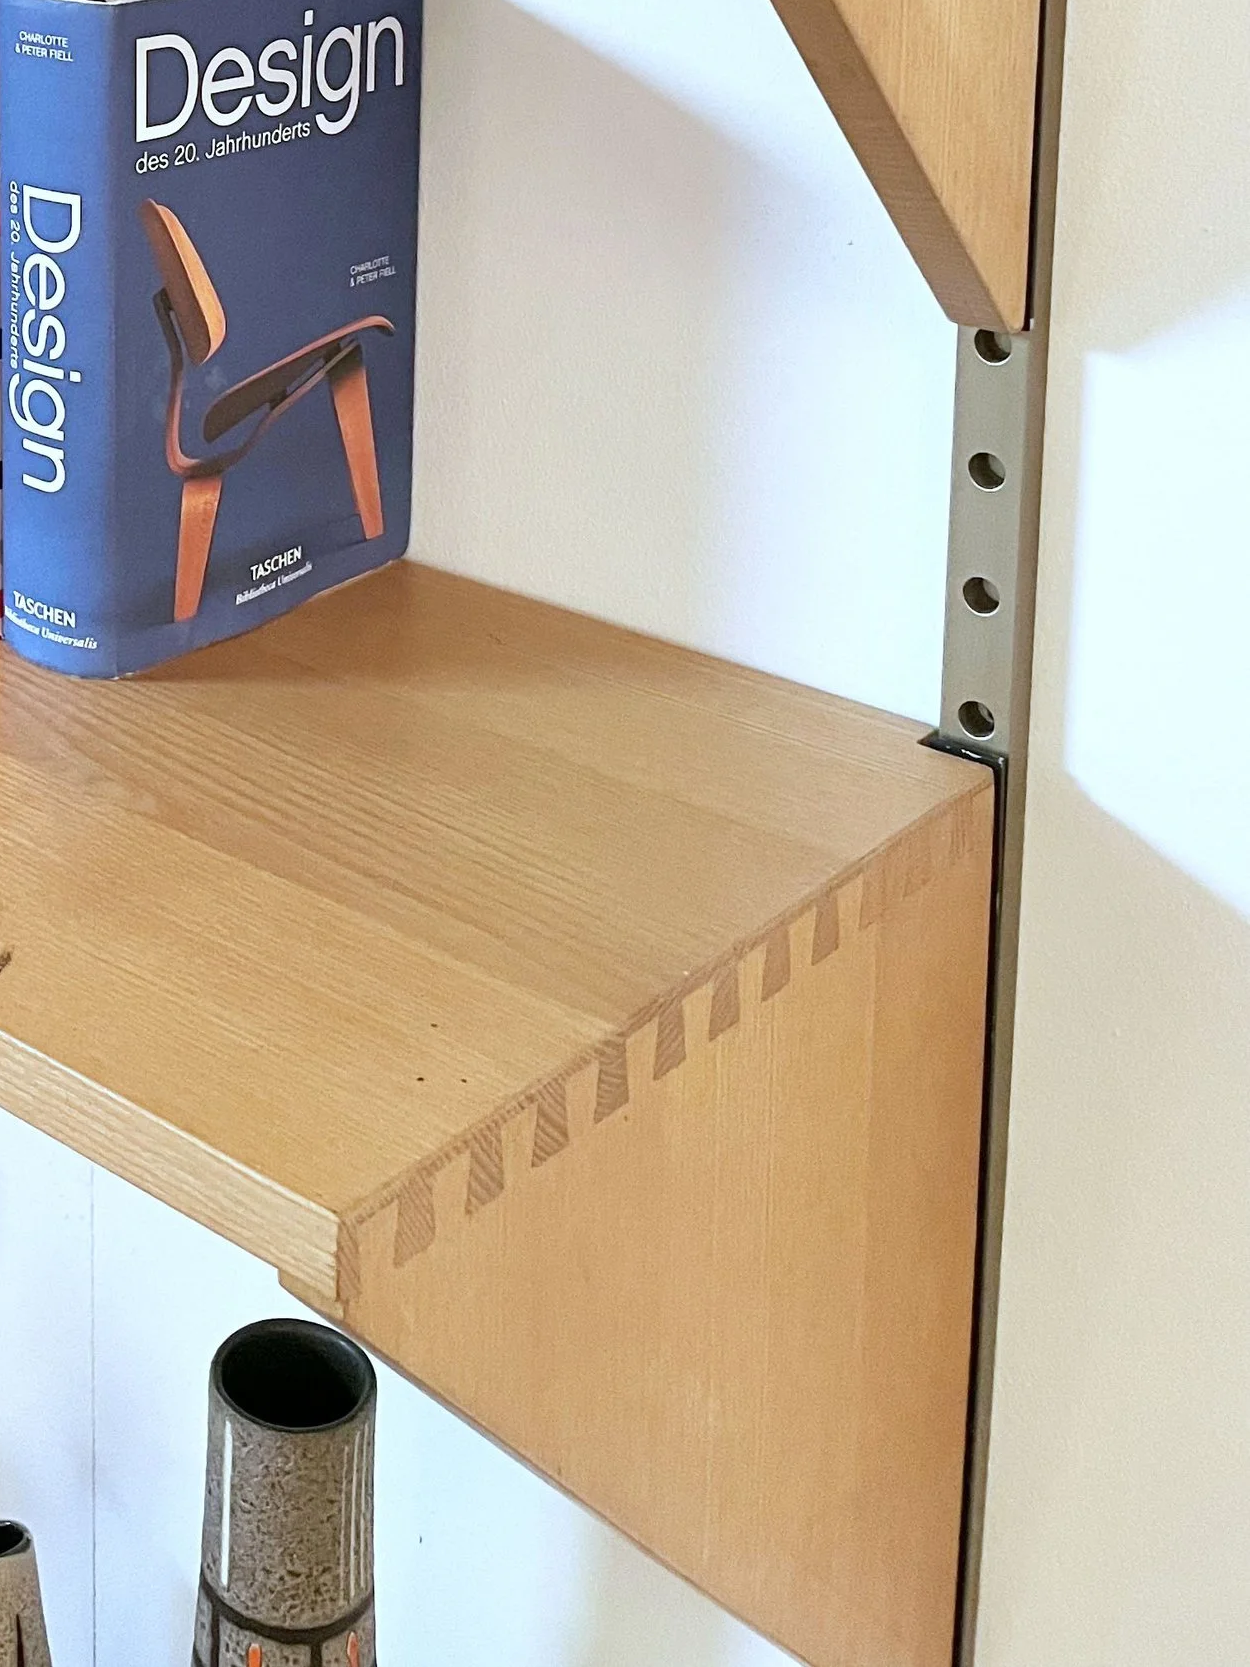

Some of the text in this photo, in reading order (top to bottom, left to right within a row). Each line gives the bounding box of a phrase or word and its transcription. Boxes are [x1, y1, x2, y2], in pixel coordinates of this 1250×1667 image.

[14, 42, 74, 63] & PETER FIELL
[19, 30, 69, 48] CHARLOTTE
[136, 9, 405, 143] Design
[135, 121, 311, 175] des 20. Jahrhunderts
[9, 180, 22, 371] des 20. Jahrhunderts
[350, 255, 390, 275] CHARLOTTE
[8, 184, 83, 494] Design
[250, 545, 302, 581] TASCHEN
[13, 590, 76, 628] TASCHEN
[41, 626, 98, 650] Universalis
